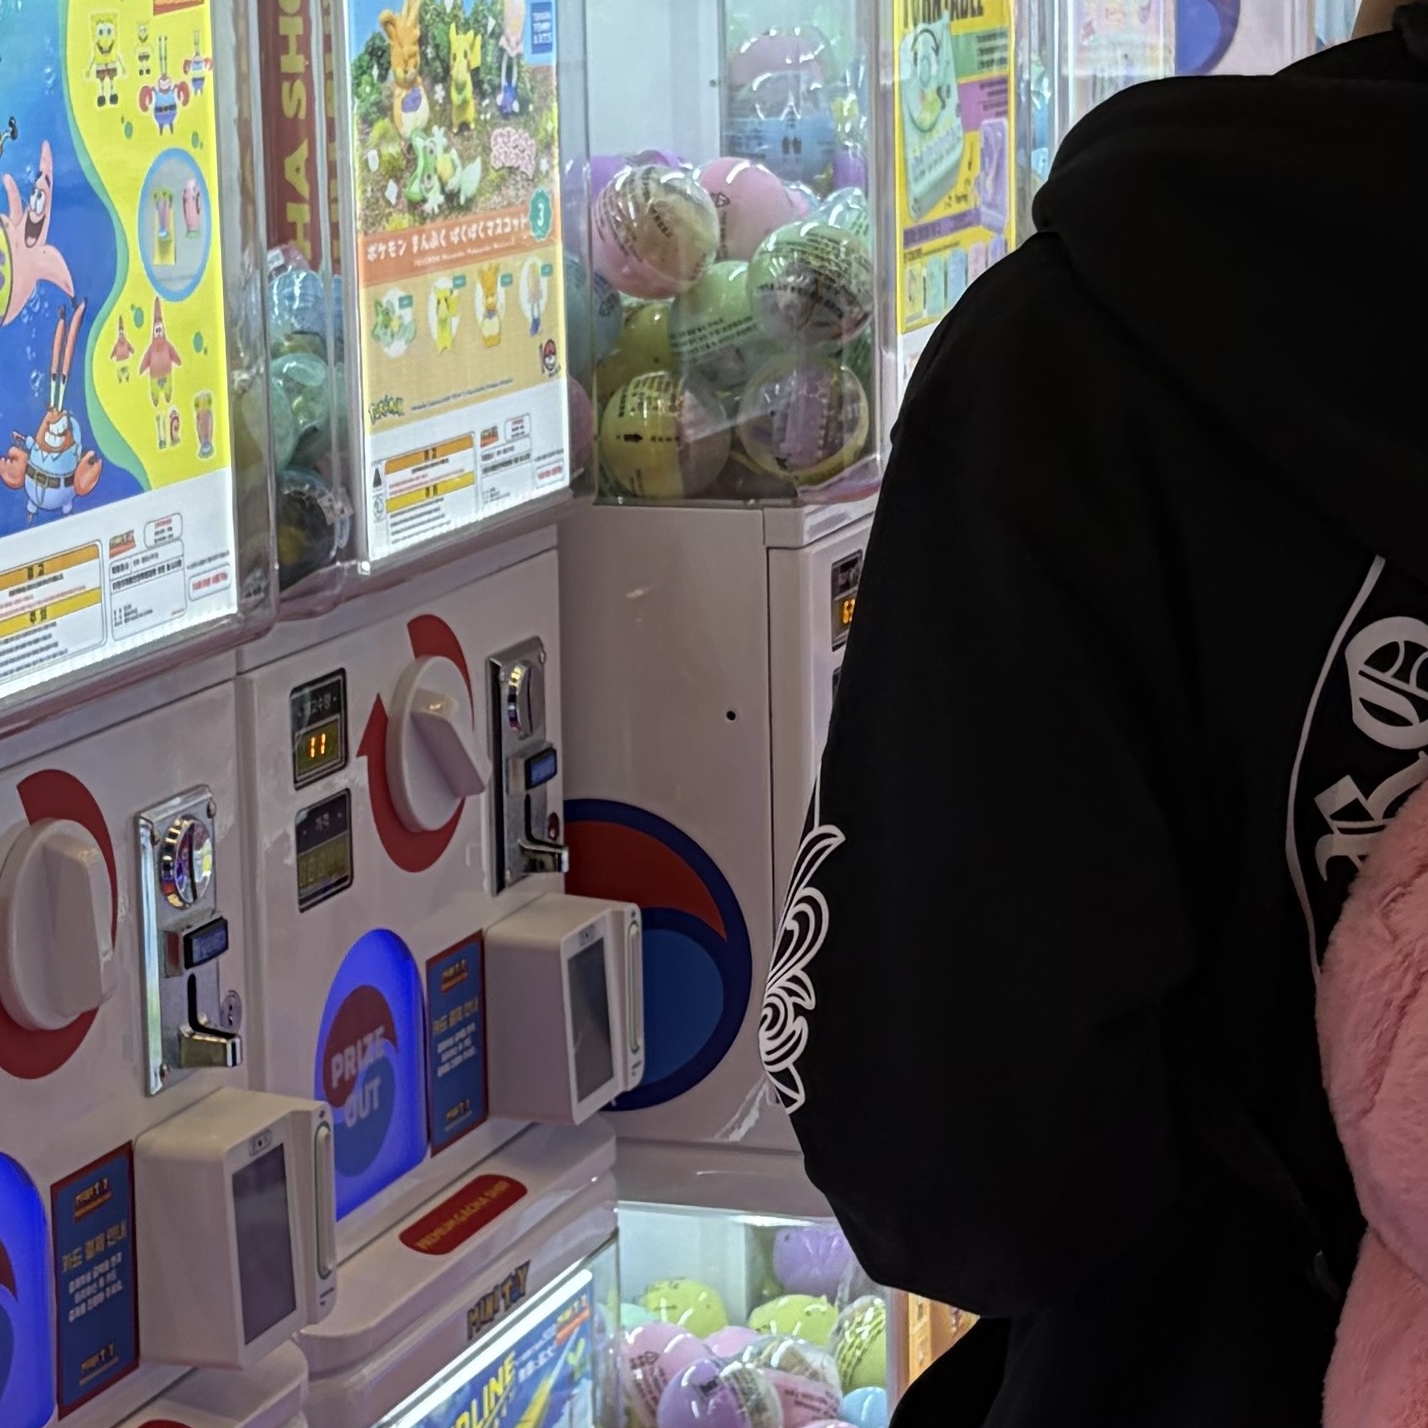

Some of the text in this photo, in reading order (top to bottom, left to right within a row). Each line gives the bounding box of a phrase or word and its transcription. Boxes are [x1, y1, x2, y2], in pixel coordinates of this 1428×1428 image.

[536, 202, 546, 227] 3
[366, 234, 407, 262] ポケモン
[331, 1027, 387, 1088] PRIZE
[343, 1077, 383, 1130] OUT
